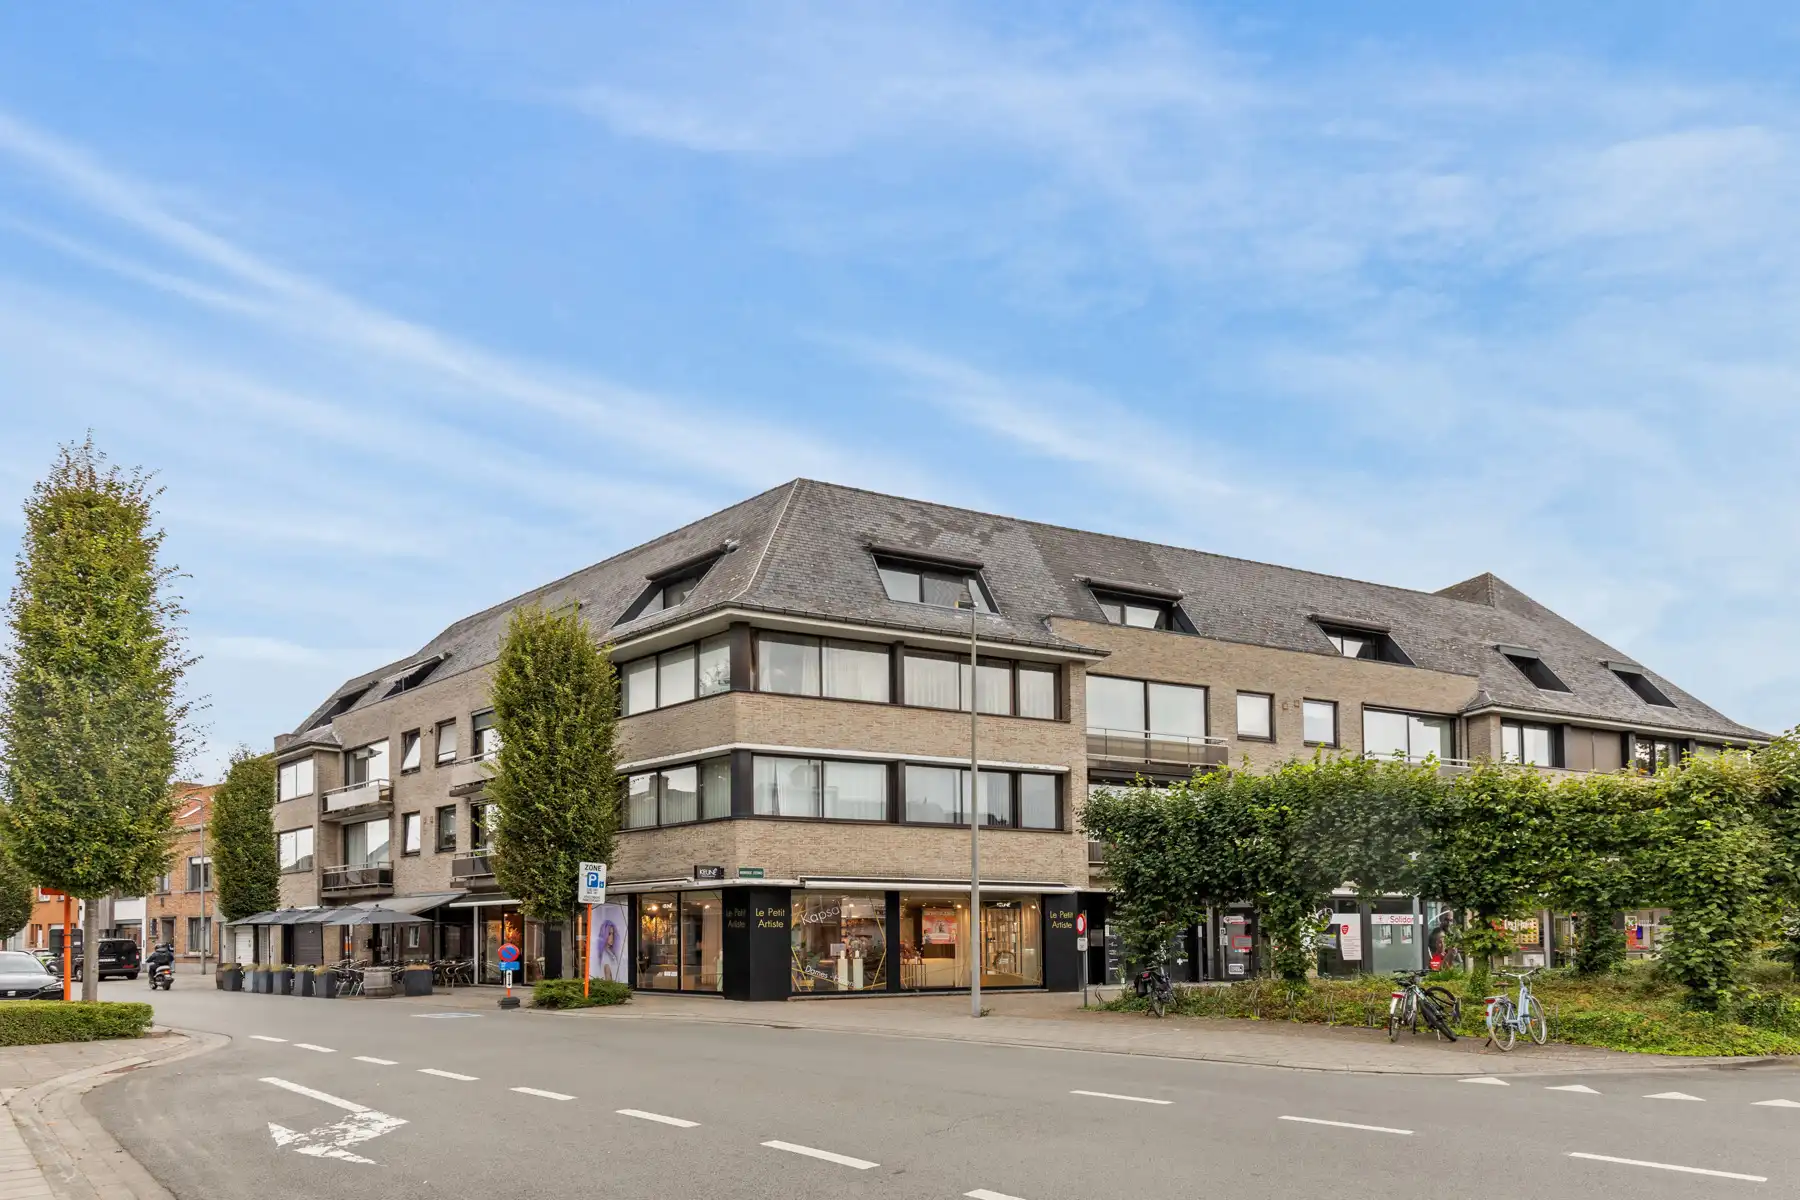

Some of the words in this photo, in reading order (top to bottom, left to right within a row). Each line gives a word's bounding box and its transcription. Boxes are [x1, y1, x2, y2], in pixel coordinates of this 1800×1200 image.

[755, 908, 765, 917] Le
[768, 908, 785, 917] Petit
[1050, 911, 1057, 919] Le
[1060, 911, 1074, 919] Petit
[758, 919, 784, 928] Artiste
[1052, 921, 1072, 929] Artiste
[805, 965, 828, 979] Dames
